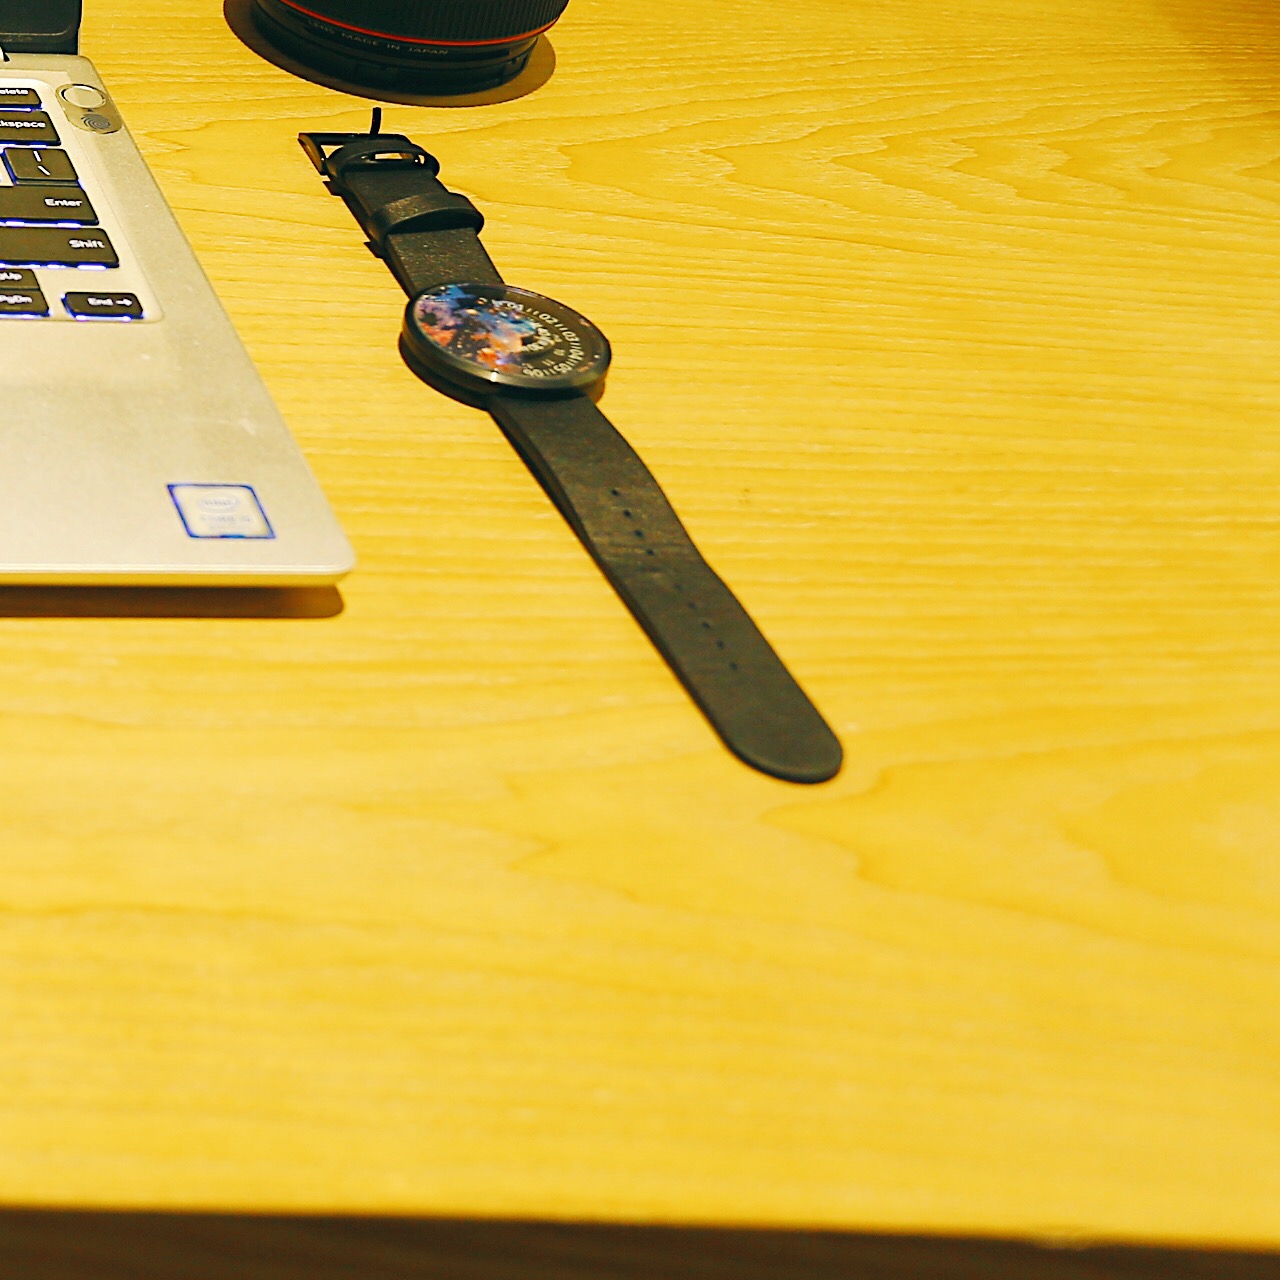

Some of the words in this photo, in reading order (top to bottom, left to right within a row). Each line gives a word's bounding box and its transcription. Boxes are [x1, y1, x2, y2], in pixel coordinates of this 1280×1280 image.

[44, 197, 83, 208] Enter
[69, 239, 106, 249] Shift
[87, 298, 114, 307] End
